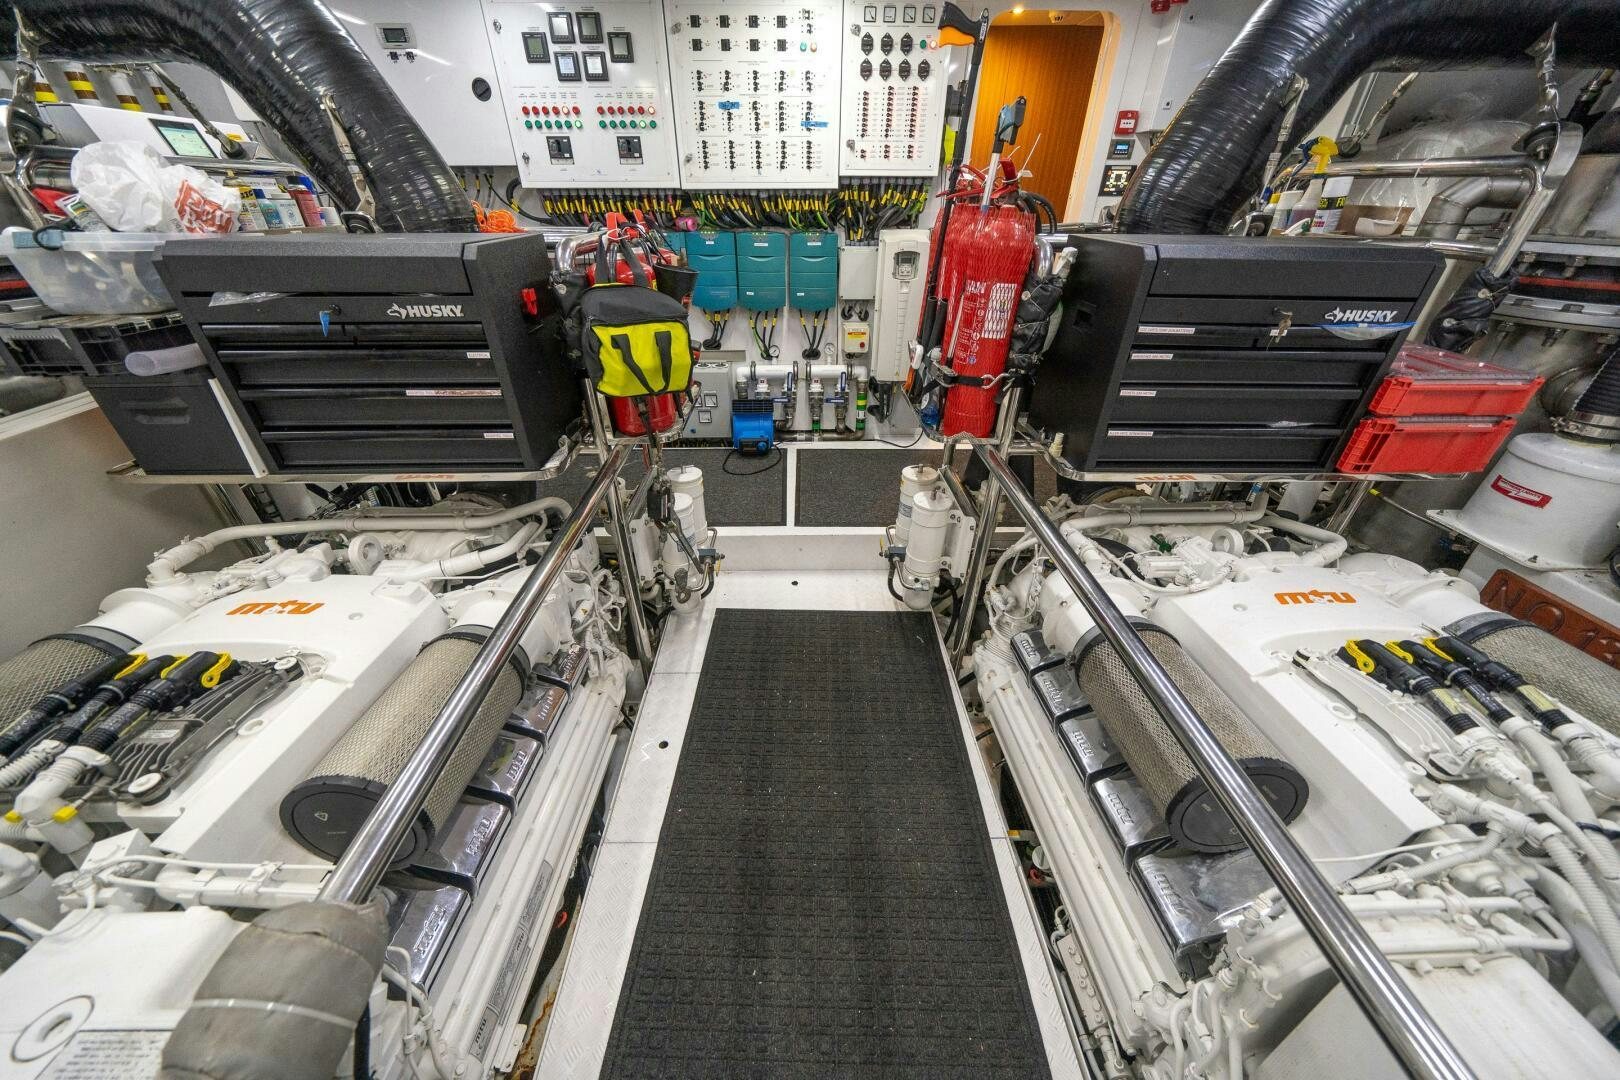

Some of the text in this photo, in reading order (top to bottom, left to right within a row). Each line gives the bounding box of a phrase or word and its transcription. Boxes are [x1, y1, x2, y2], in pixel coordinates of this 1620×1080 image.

[406, 305, 463, 317] HUSKY
[1341, 310, 1398, 322] HUSKY
[1274, 589, 1357, 605] mtu
[225, 600, 326, 616] mtu
